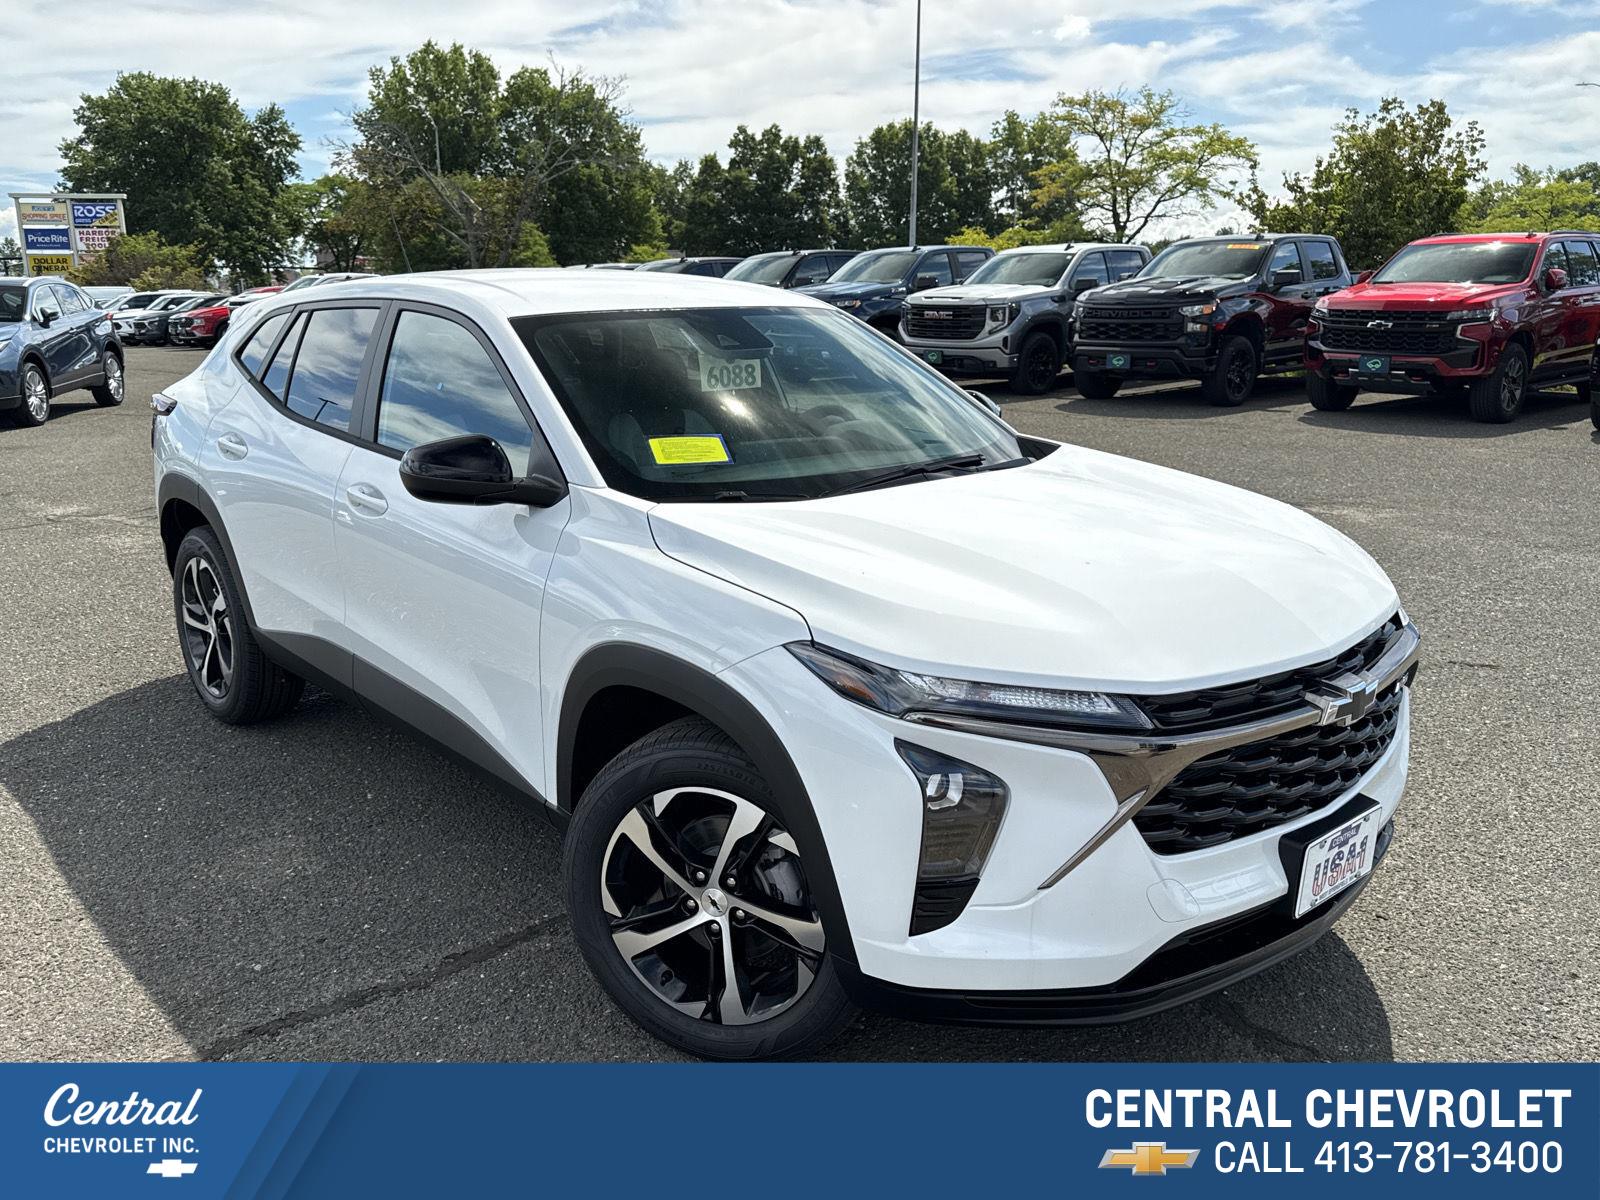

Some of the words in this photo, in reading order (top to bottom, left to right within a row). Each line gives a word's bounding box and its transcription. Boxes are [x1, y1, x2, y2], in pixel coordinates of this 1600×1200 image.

[73, 206, 115, 217] ROSS
[27, 234, 50, 243] Price
[50, 234, 69, 243] Rite
[33, 257, 69, 265] DOLLAR
[924, 310, 953, 319] GMC
[706, 363, 757, 390] 6088
